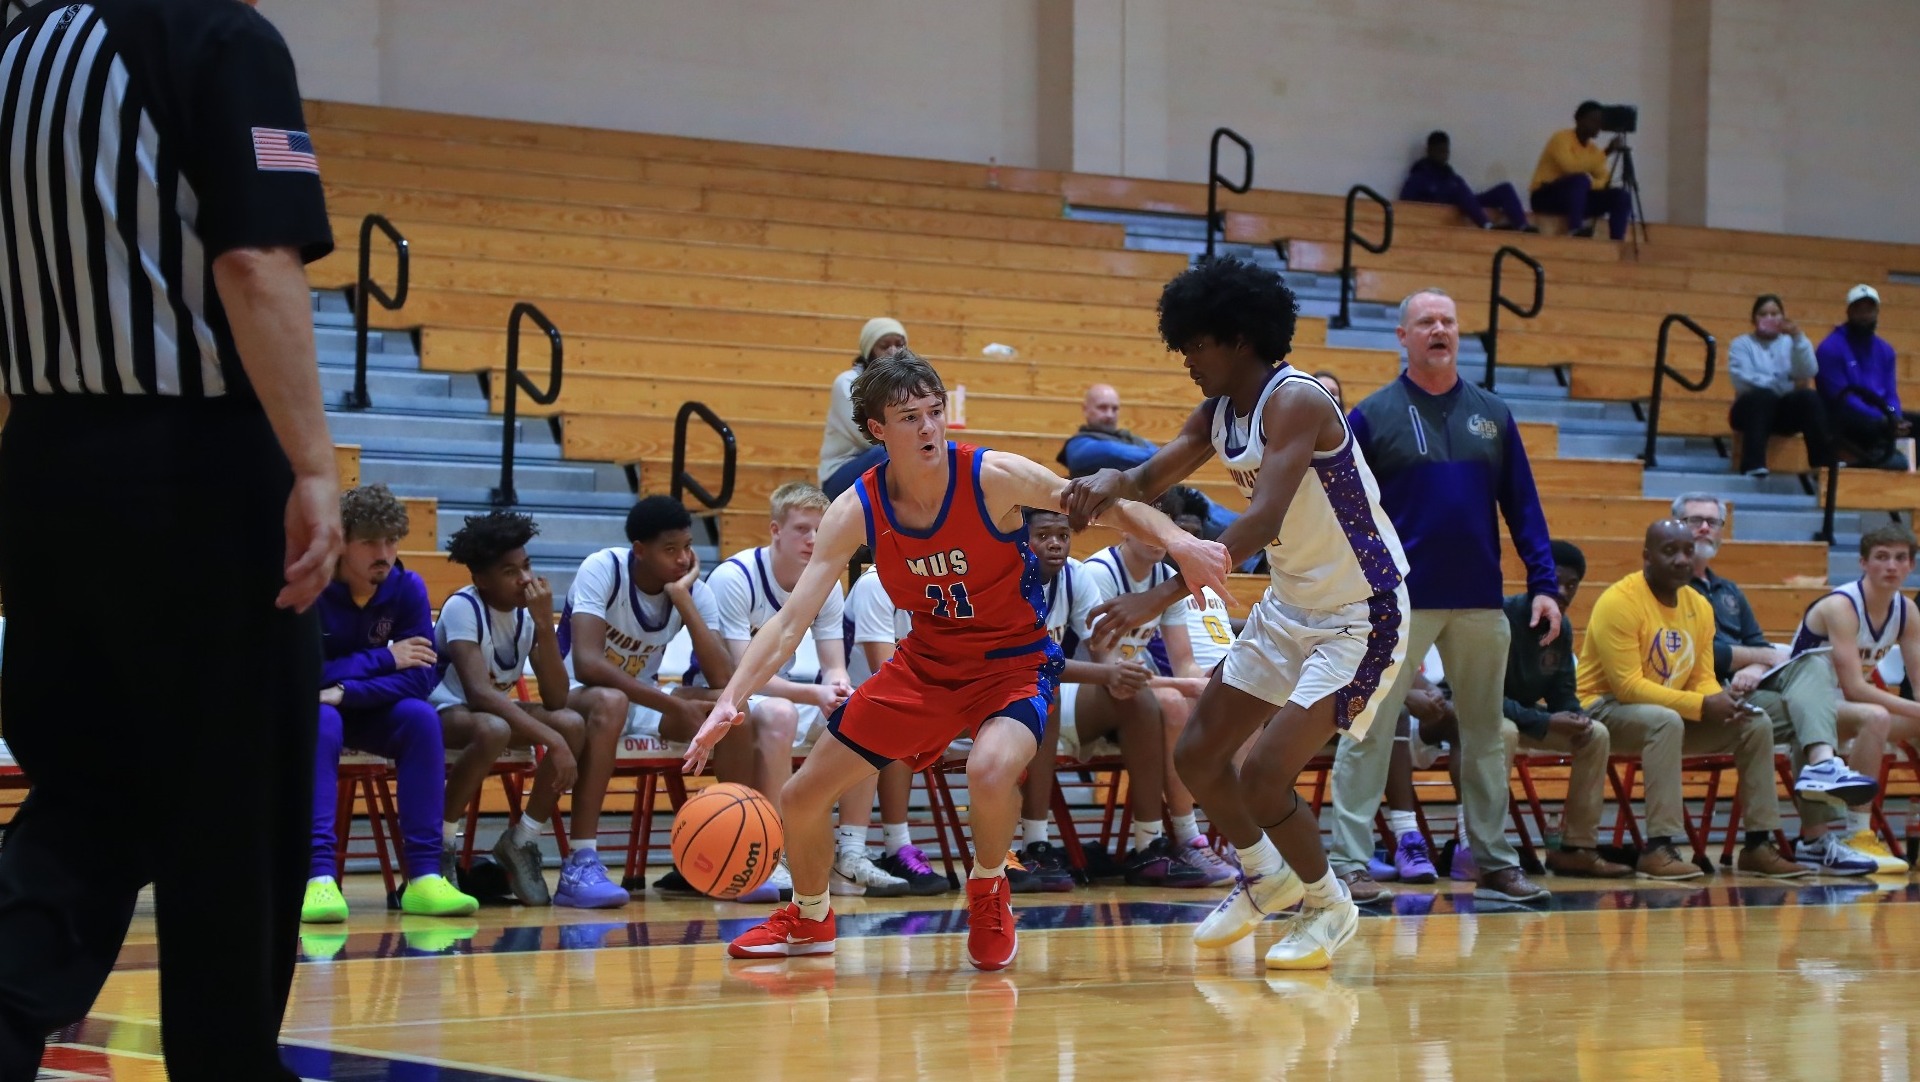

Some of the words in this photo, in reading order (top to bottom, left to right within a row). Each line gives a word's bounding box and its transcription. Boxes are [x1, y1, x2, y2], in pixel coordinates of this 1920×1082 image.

[905, 548, 968, 577] MUS
[925, 581, 975, 619] 11
[1202, 615, 1231, 645] 0
[624, 738, 669, 751] OWLS
[719, 842, 762, 897] Wilson
